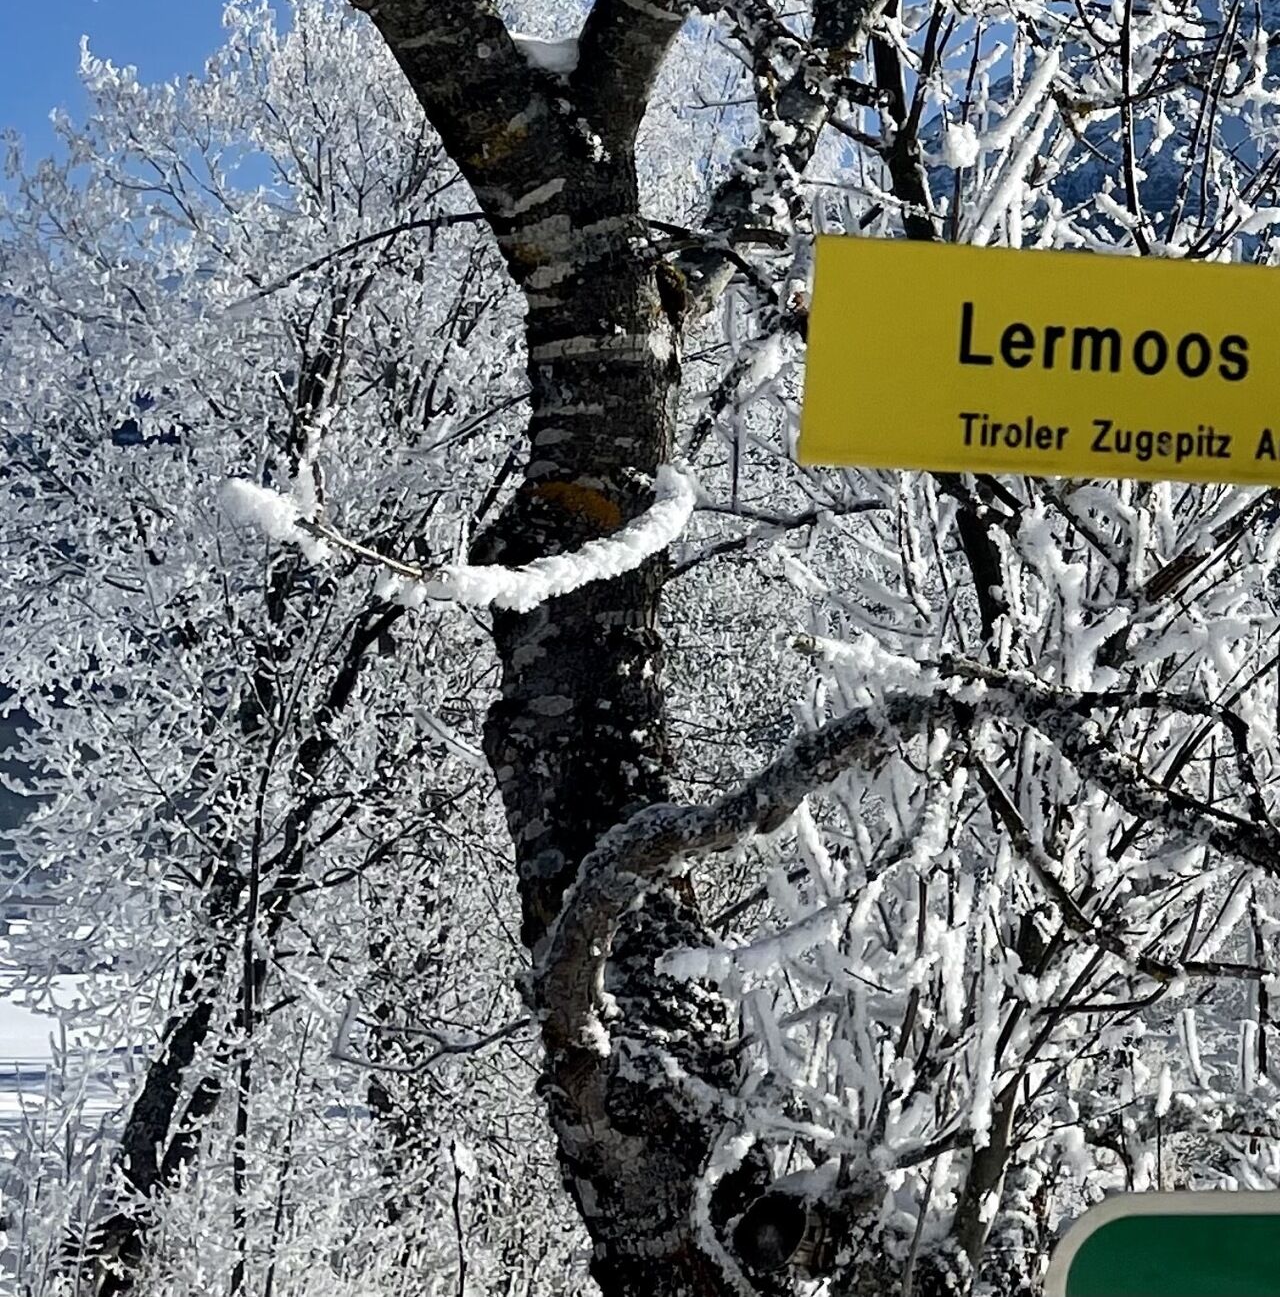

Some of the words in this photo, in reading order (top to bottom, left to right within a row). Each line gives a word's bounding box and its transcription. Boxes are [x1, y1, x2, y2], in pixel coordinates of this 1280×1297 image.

[958, 301, 1250, 382] Lermoos
[959, 412, 1069, 451] Tiroler
[1091, 419, 1232, 463] Zugspitz
